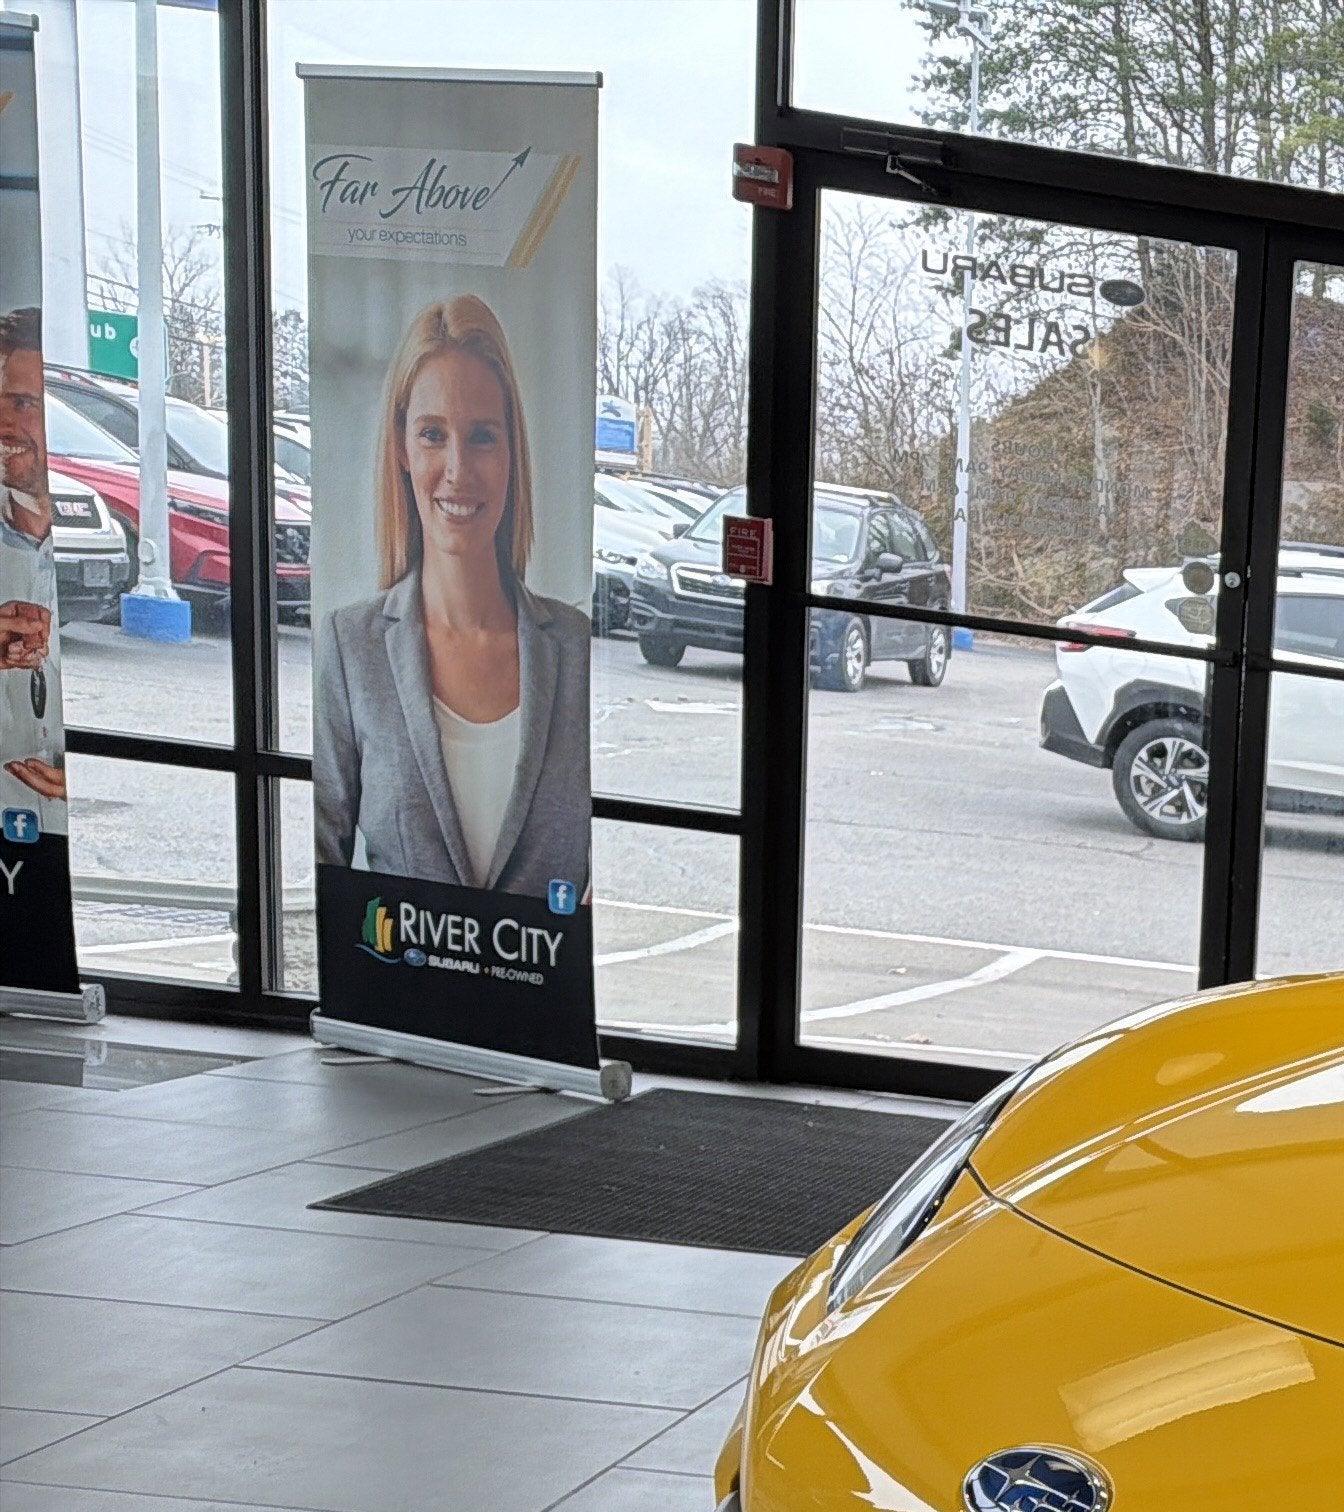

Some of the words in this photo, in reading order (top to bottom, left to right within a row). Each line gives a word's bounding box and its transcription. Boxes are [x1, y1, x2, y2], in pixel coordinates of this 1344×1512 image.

[312, 153, 378, 213] Far
[378, 157, 491, 219] Above
[347, 227, 377, 243] your
[379, 227, 467, 247] expectations
[90, 323, 117, 340] ub
[729, 526, 757, 538] FIRE
[0, 858, 24, 895] Y
[399, 902, 481, 955] RIVER
[492, 918, 563, 967] CITY
[428, 954, 480, 974] SUBARU
